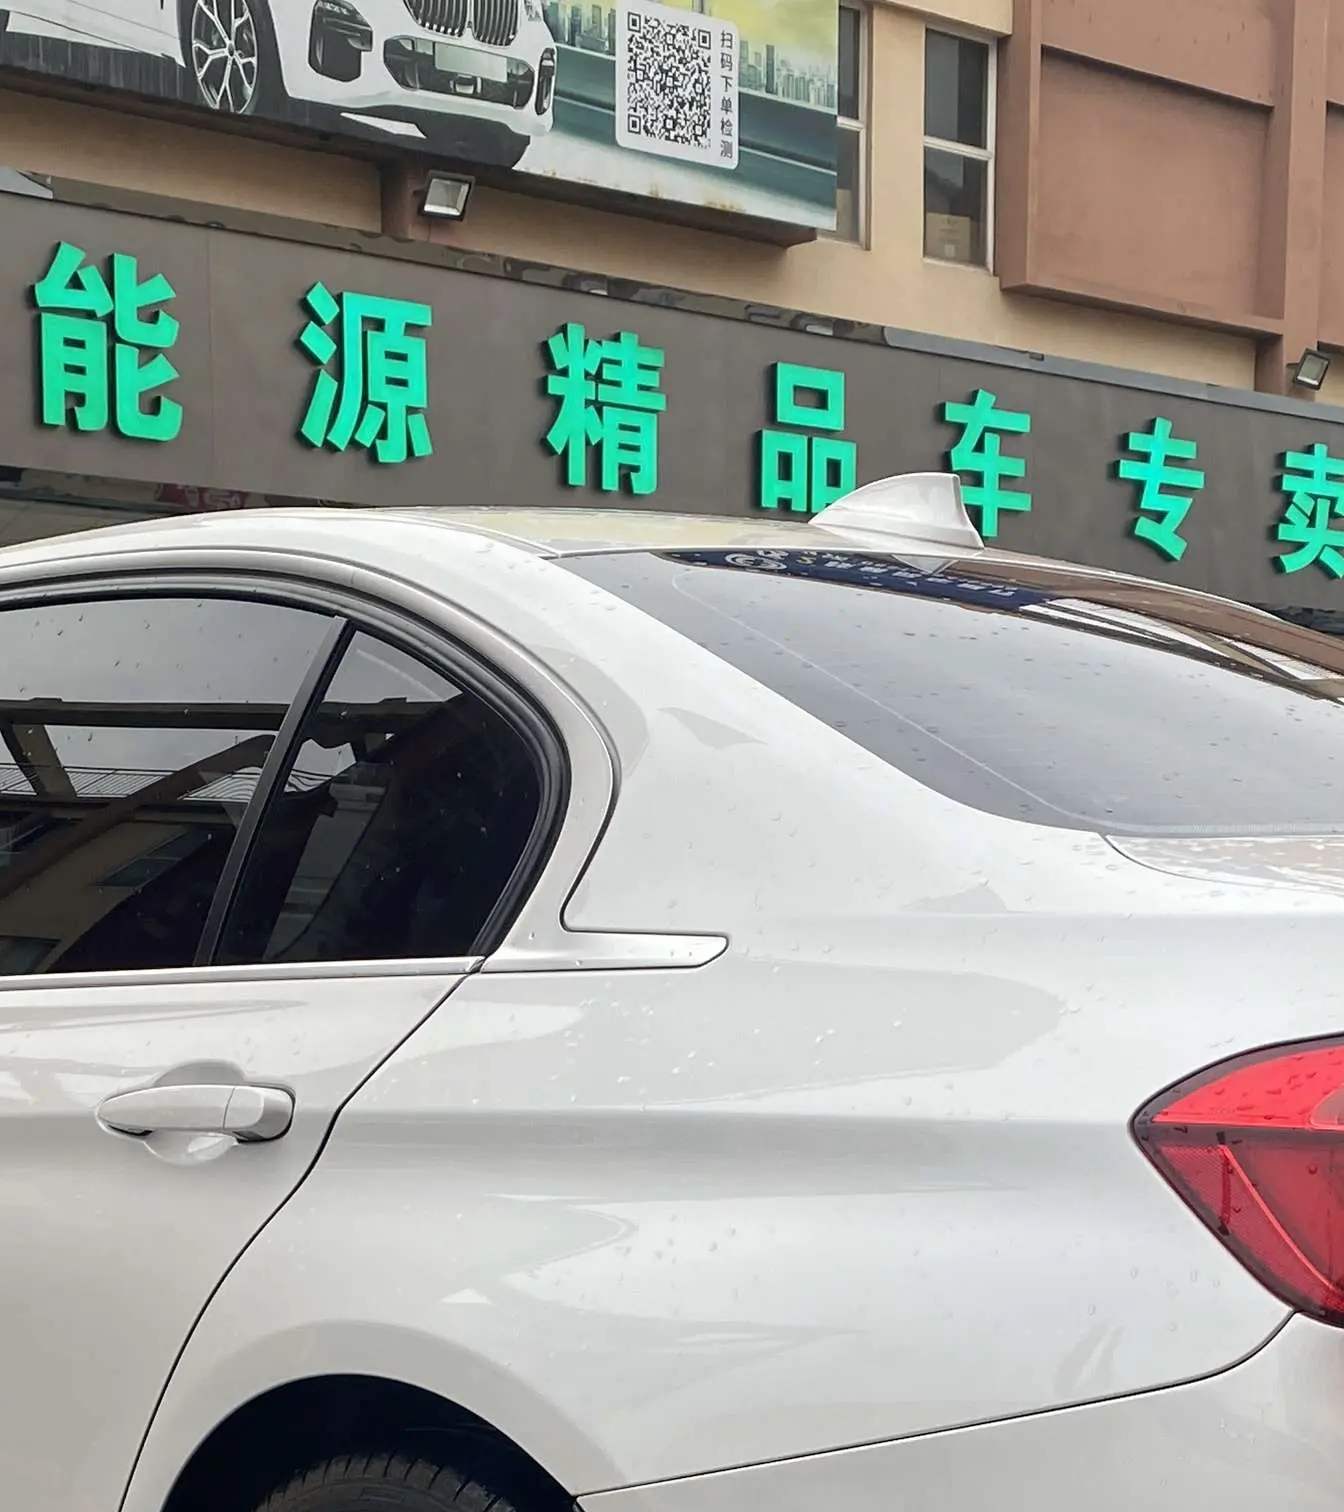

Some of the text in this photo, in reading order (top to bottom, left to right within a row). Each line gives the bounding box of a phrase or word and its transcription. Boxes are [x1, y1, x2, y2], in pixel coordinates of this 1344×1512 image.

[720, 29, 734, 159] 扫码下单检测
